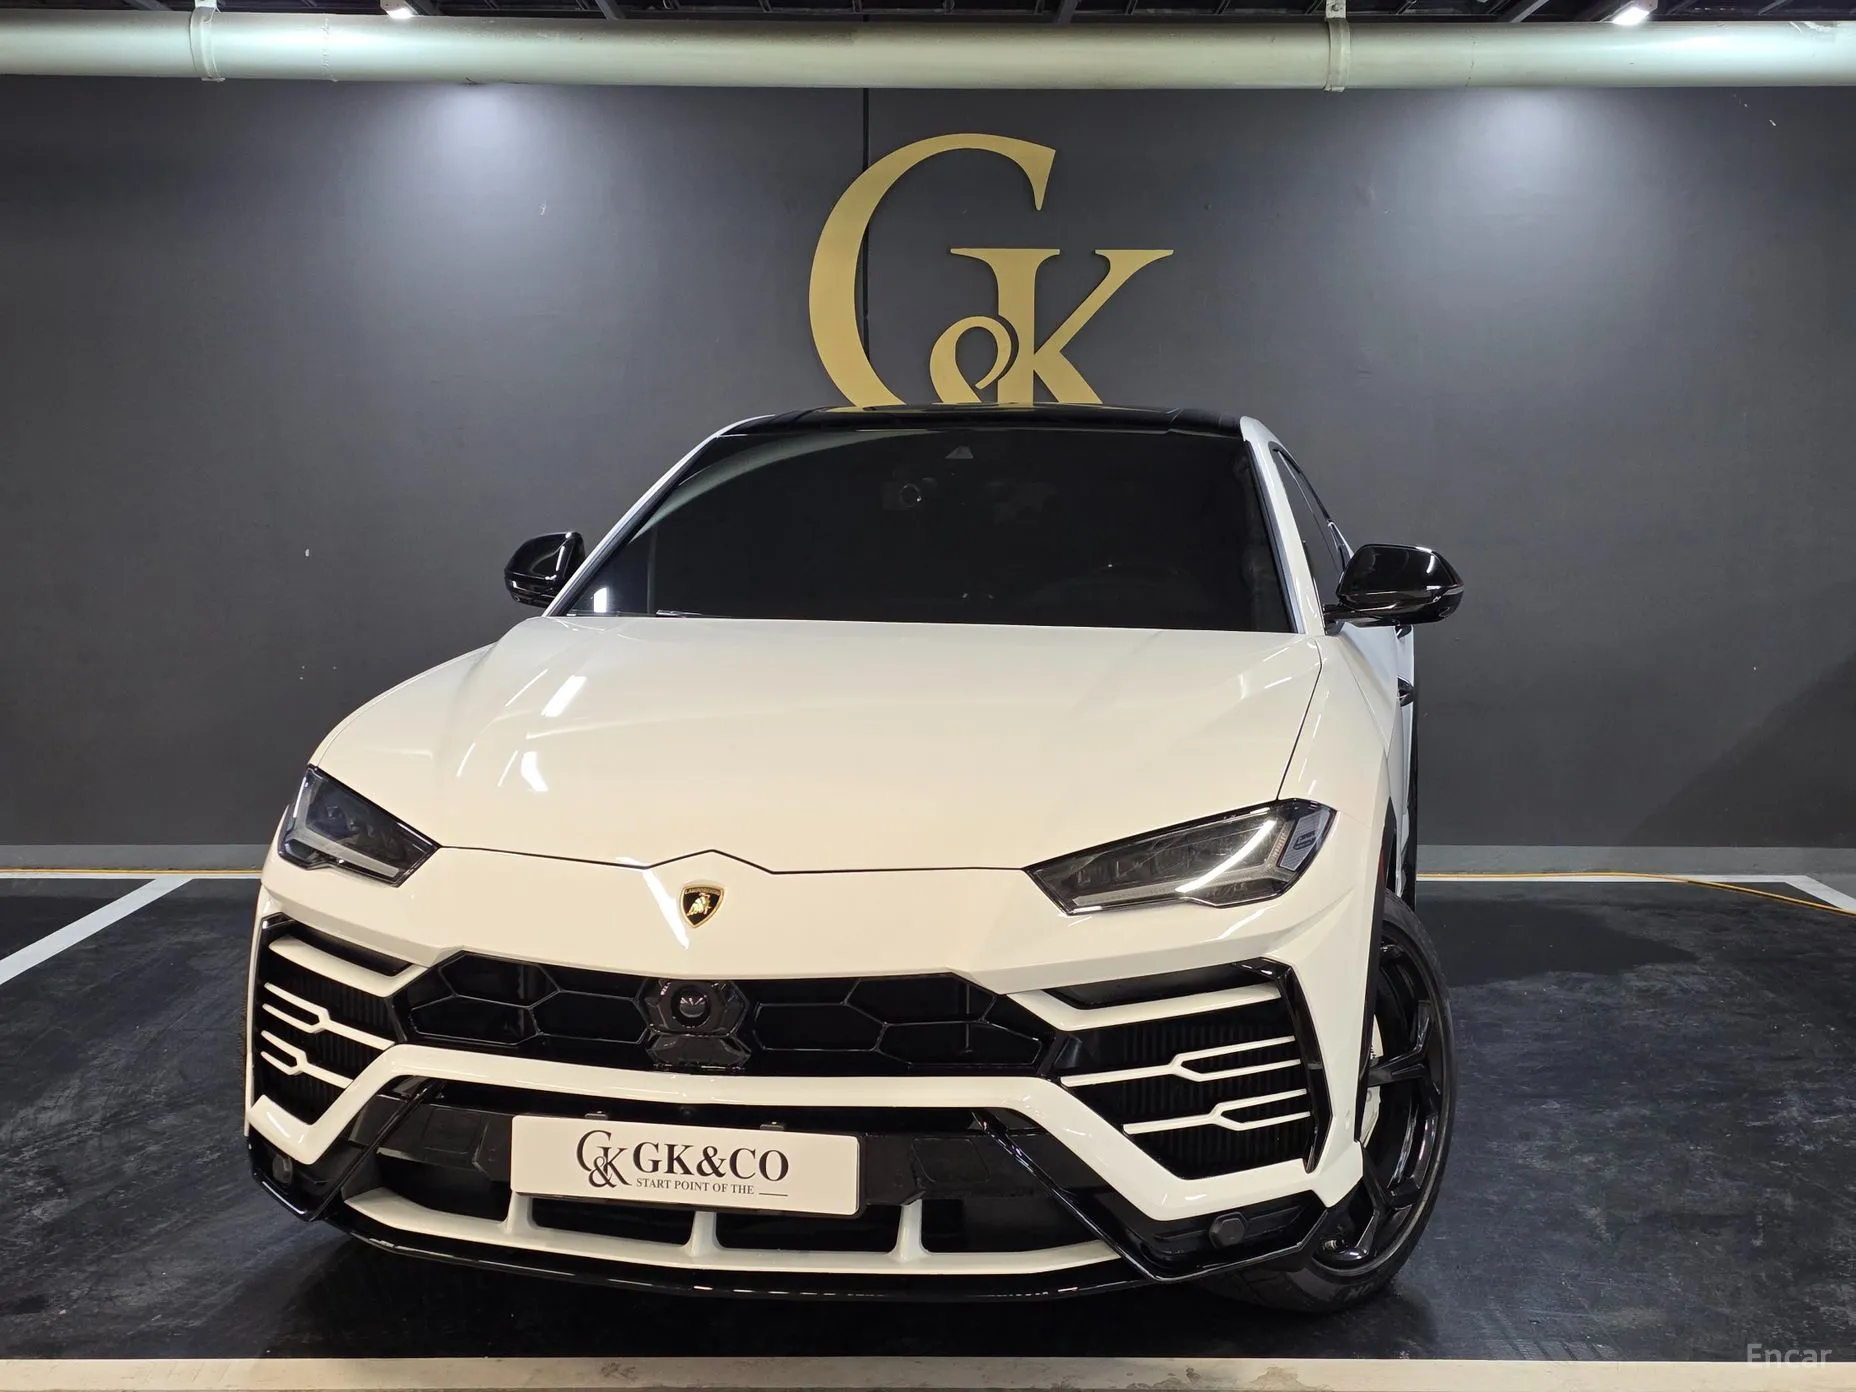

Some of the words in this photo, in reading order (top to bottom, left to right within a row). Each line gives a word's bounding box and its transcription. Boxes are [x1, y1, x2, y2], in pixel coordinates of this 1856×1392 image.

[632, 1141, 789, 1182] GK&CO
[636, 1177, 671, 1189] START
[674, 1180, 710, 1192] POINT
[712, 1182, 728, 1193] OF
[730, 1184, 755, 1195] THE
